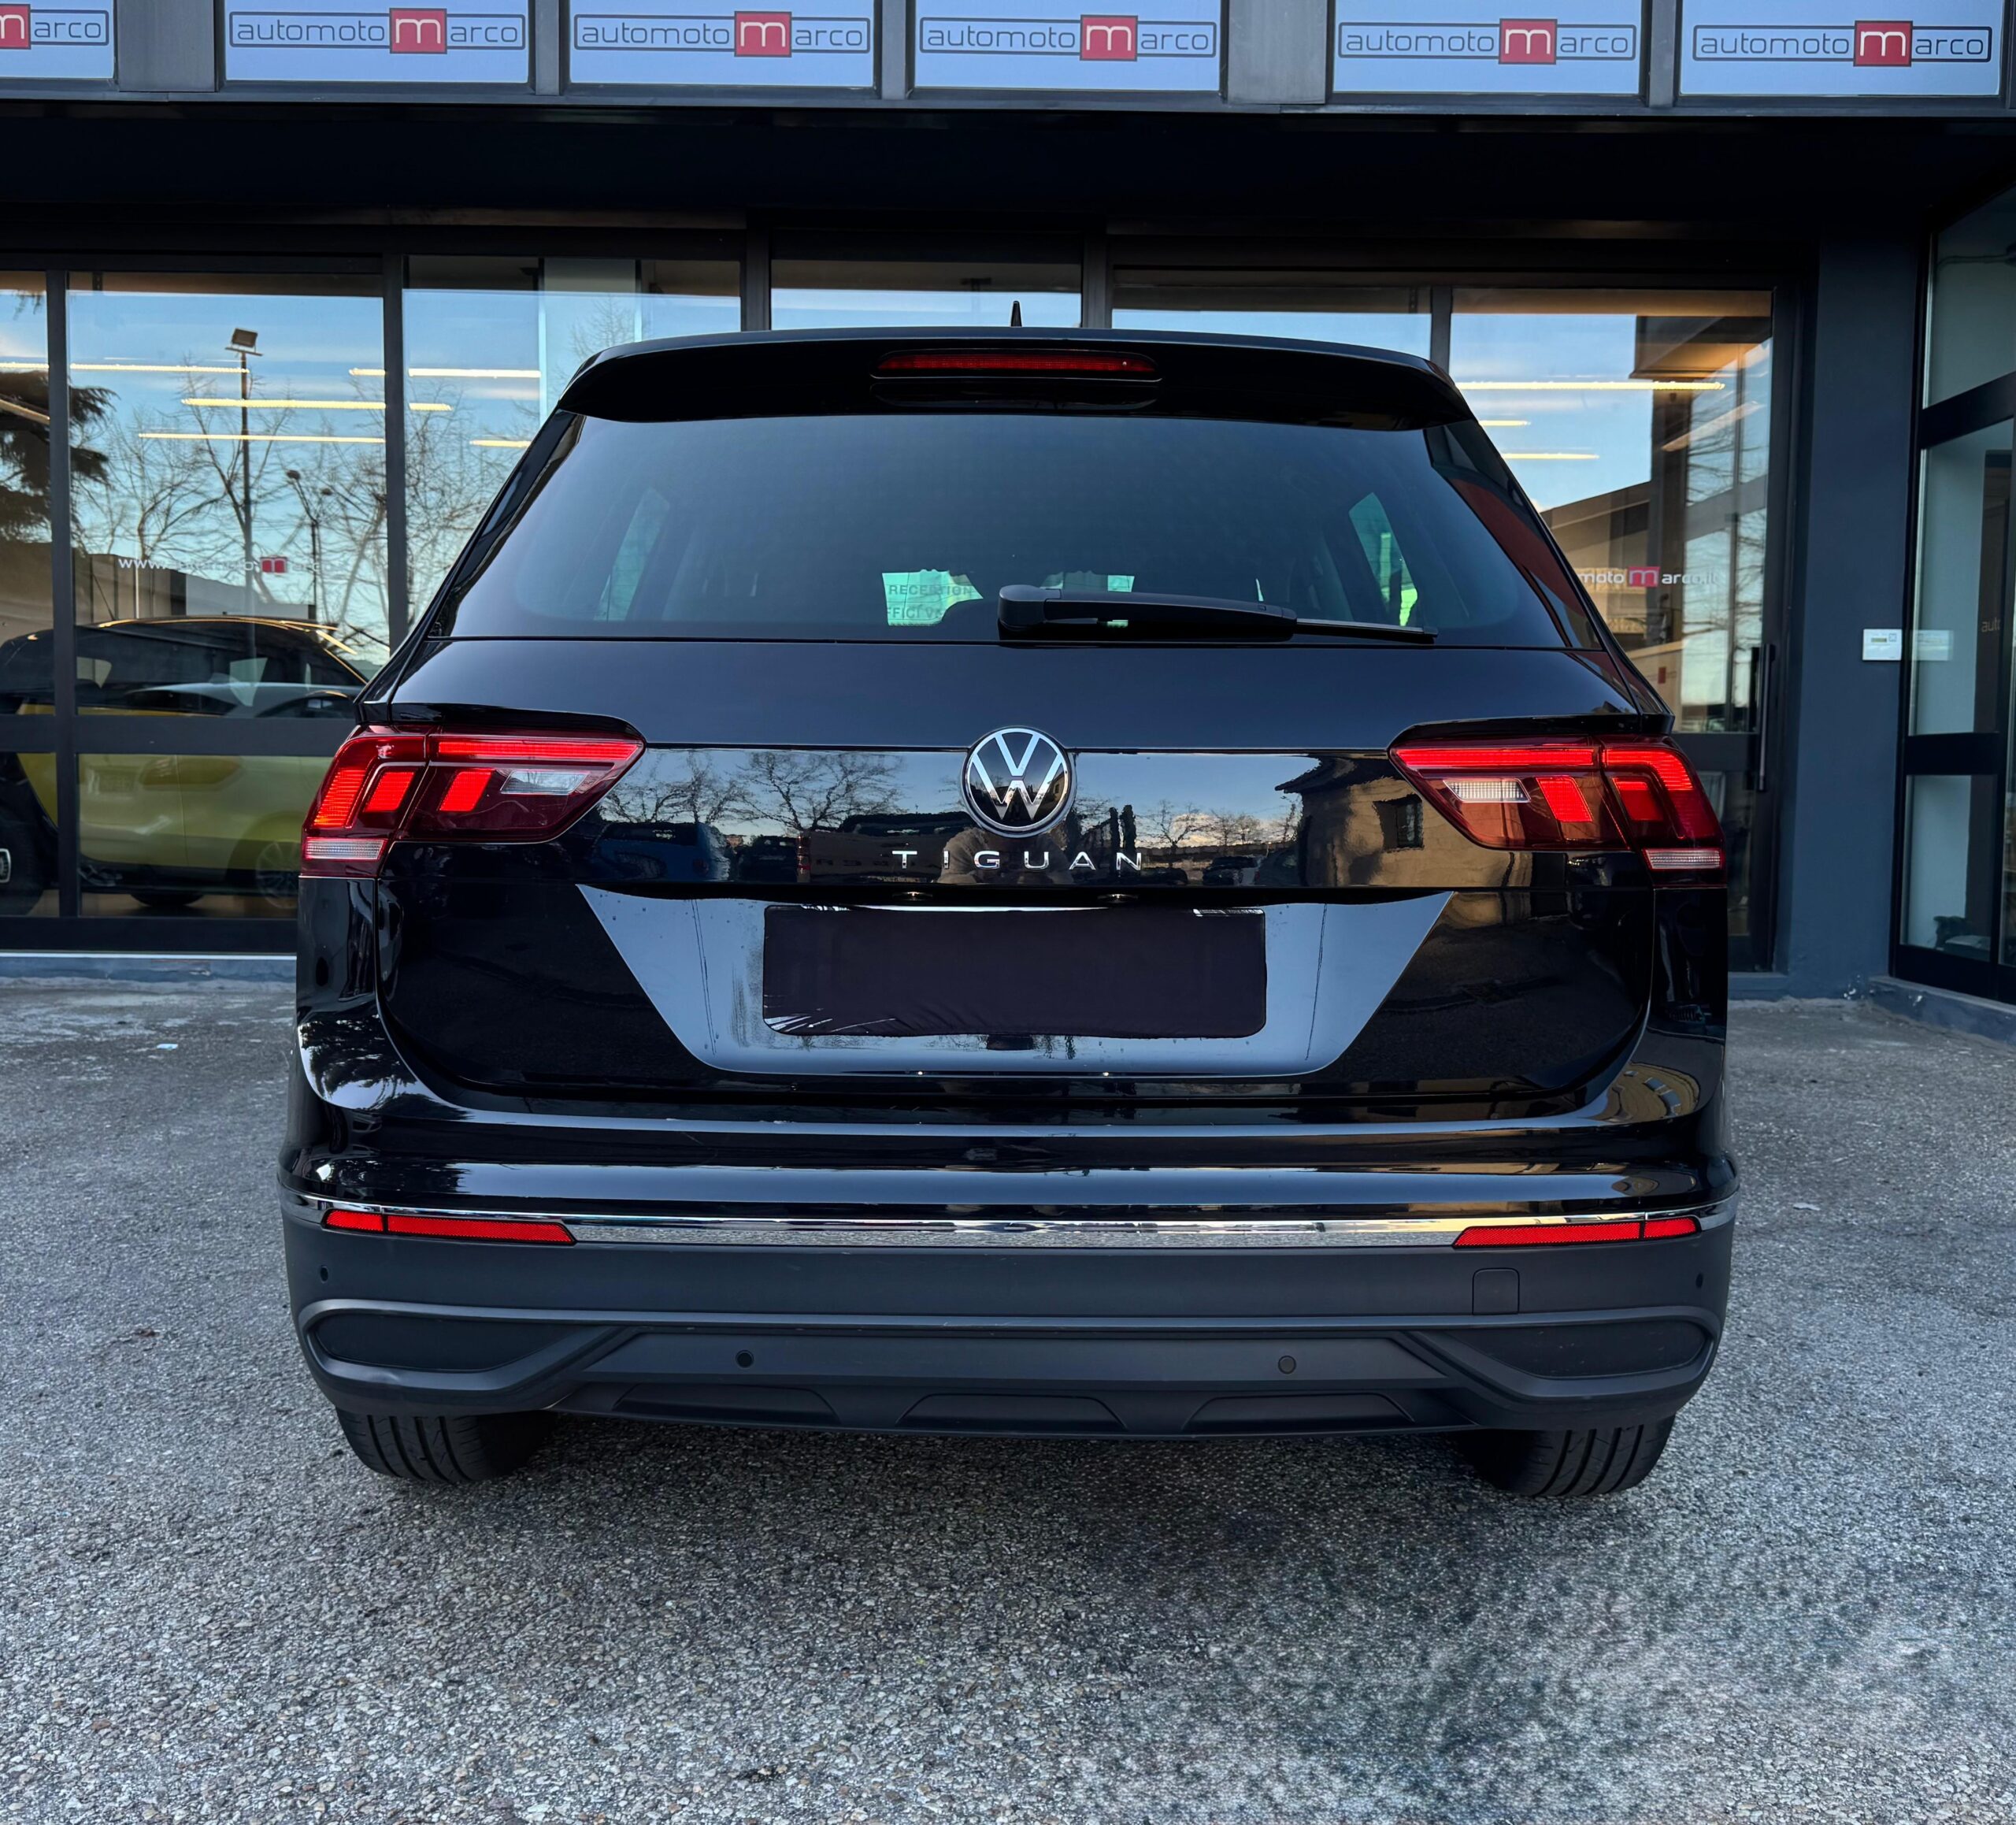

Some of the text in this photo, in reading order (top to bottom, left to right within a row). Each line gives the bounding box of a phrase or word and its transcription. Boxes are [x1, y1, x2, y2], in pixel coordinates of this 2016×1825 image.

[237, 19, 385, 42] automoto
[582, 22, 730, 45] automoto
[927, 25, 1076, 48] automoto
[1346, 29, 1495, 52] automoto
[1700, 32, 1850, 54] automoto
[892, 850, 1142, 871] TIGUAN
